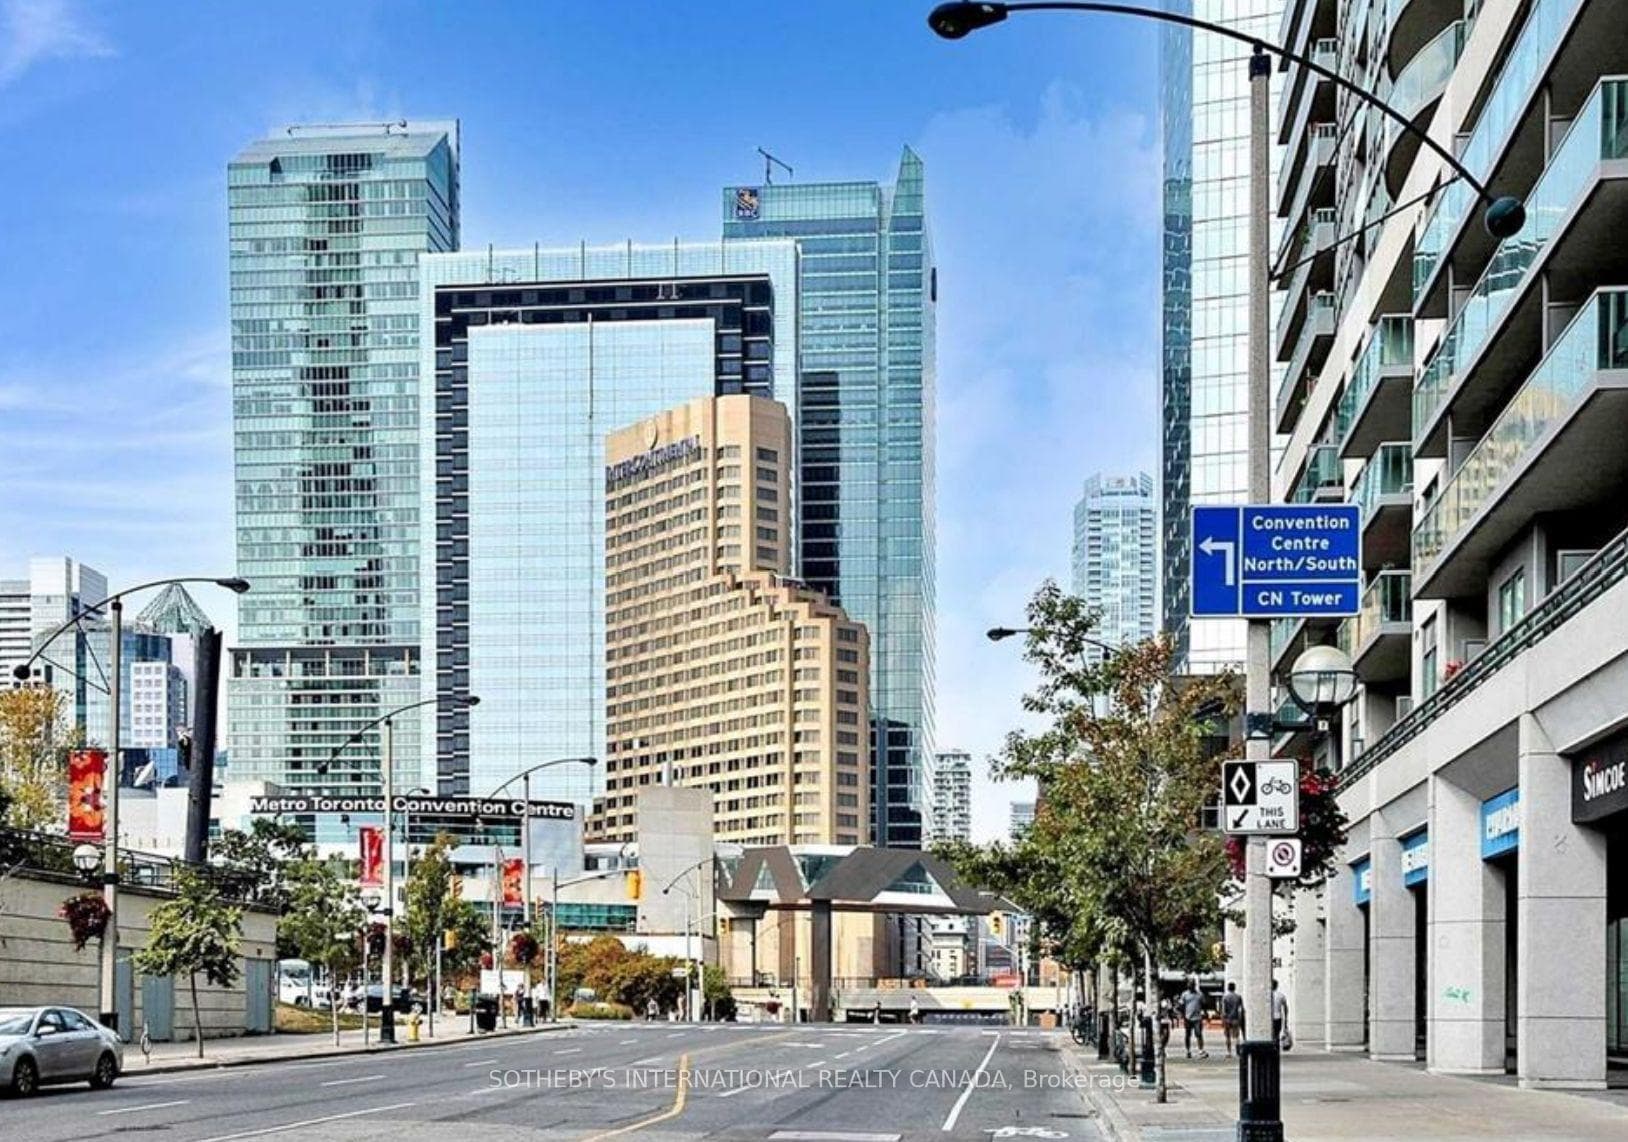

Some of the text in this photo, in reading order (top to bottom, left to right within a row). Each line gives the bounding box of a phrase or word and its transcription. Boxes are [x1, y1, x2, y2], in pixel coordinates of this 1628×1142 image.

[1252, 515, 1350, 530] Convention
[1271, 536, 1330, 550] Centre
[1244, 556, 1357, 571] North/South
[1257, 591, 1343, 606] CN Tower
[250, 797, 307, 811] Metro
[312, 796, 386, 811] Toronto
[392, 796, 507, 815] Convention
[1259, 807, 1285, 817] THIS
[1256, 819, 1287, 829] LANE
